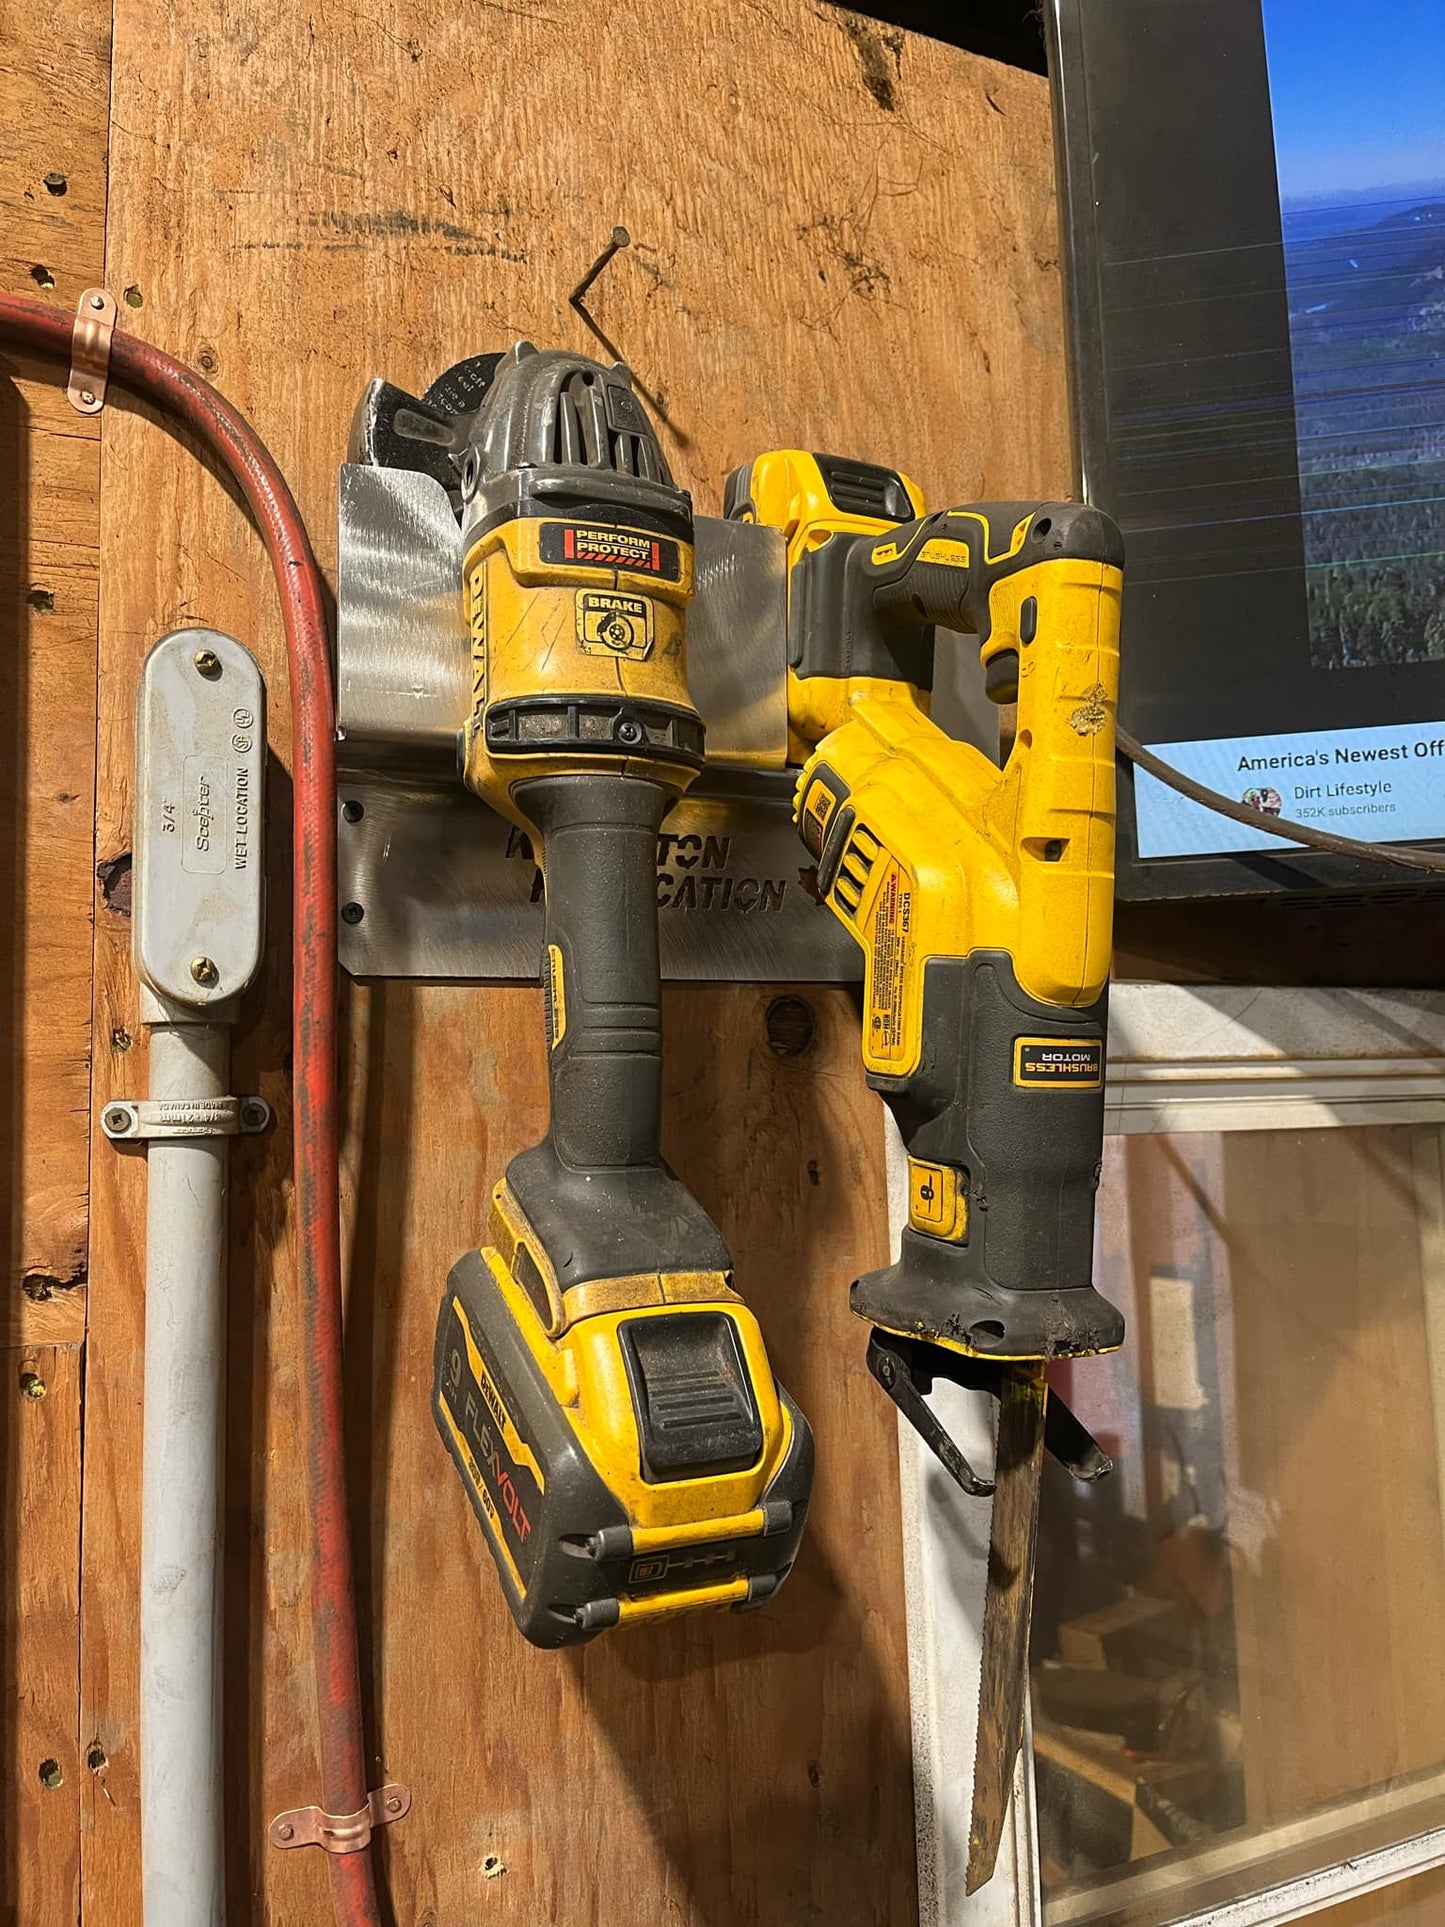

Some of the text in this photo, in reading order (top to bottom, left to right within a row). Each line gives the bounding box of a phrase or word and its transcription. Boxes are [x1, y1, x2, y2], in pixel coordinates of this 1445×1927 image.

[576, 530, 650, 548] PERFORM
[576, 541, 649, 560] PROTECT
[588, 596, 643, 613] BRAKE
[470, 564, 486, 736] DEWALT
[1237, 739, 1445, 771] America's Newest Off
[234, 767, 249, 834] LOCATION
[1295, 780, 1392, 800] Dirt Lifestyle
[191, 775, 213, 852] Scepter
[1295, 803, 1397, 819] 352K subscribers
[234, 840, 249, 869] WET
[902, 892, 911, 933] DCS367
[1024, 1062, 1098, 1073] BRUSHLESS
[1042, 1053, 1091, 1062] MOTOR
[450, 1348, 462, 1388] 9
[480, 1370, 508, 1433] DEWALT
[465, 1391, 532, 1543] FLEXVOLT
